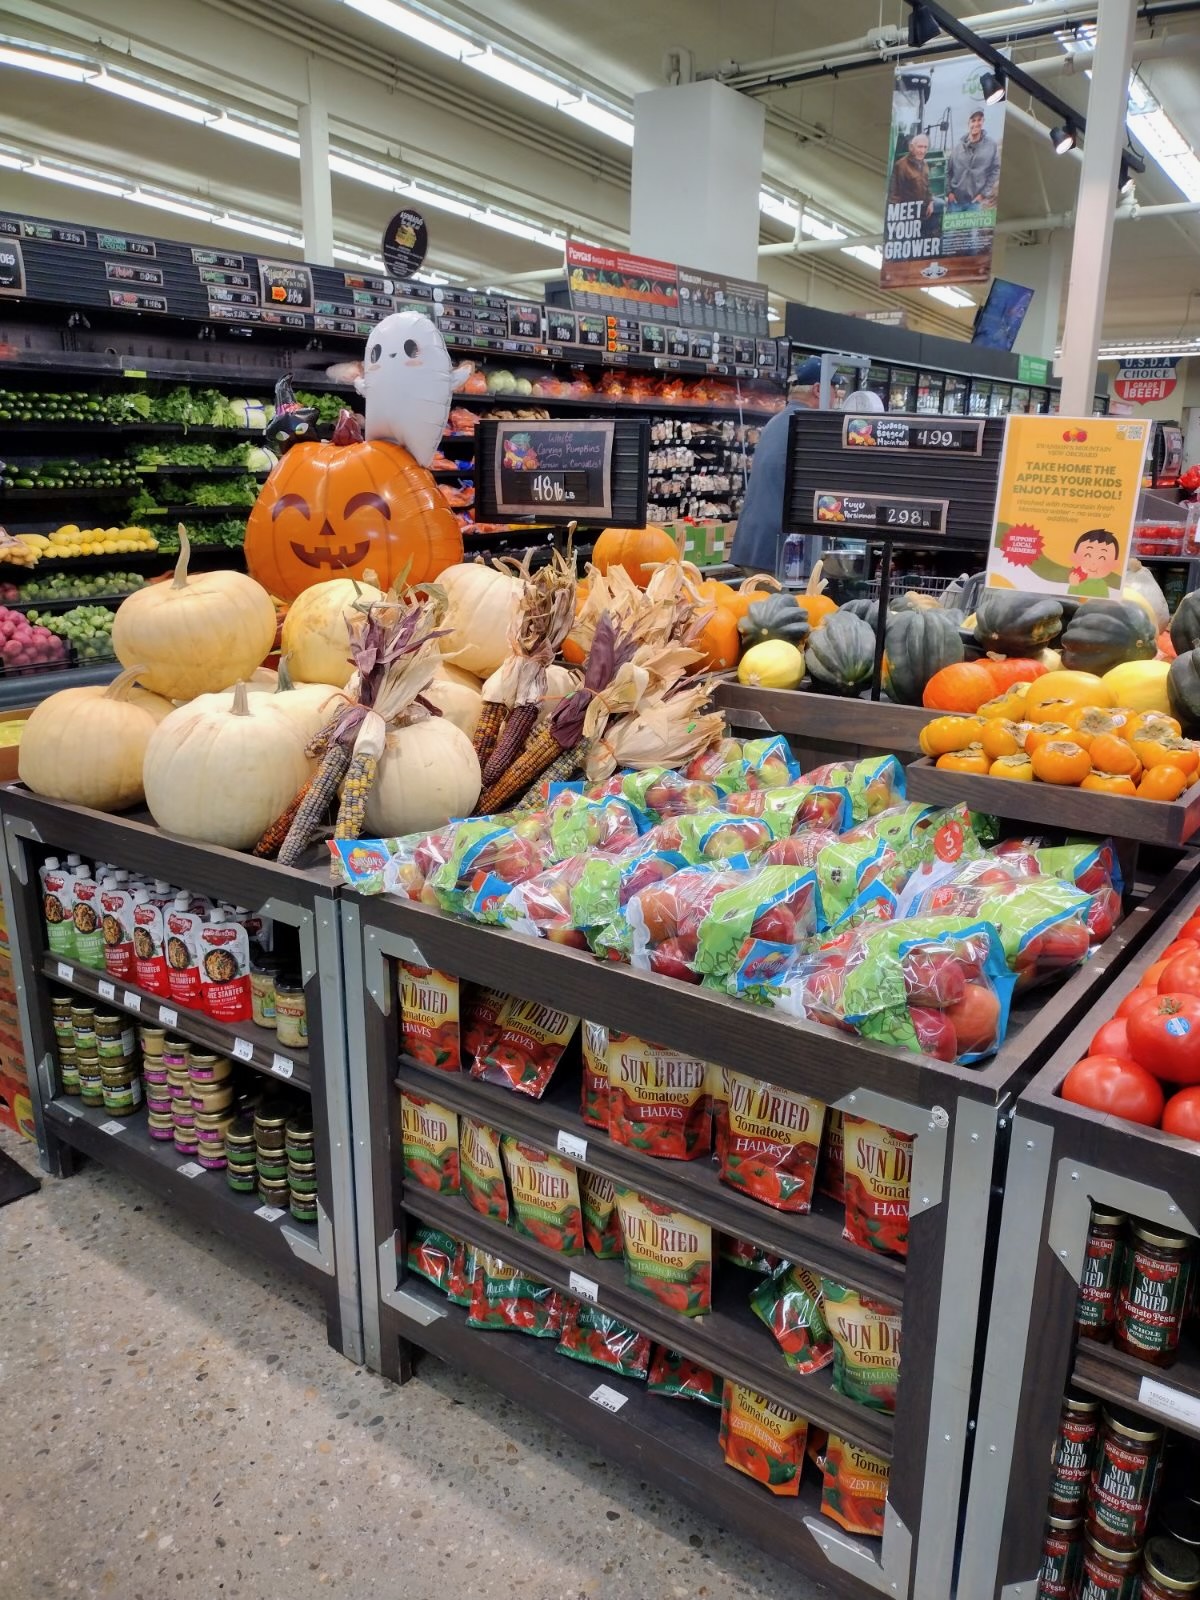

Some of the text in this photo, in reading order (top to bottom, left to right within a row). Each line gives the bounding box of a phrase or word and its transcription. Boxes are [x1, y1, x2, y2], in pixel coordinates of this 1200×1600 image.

[887, 201, 923, 221] MEET
[887, 220, 921, 240] YOUR
[944, 217, 991, 228] CARPINITO
[885, 238, 940, 259] GROWER
[1124, 369, 1169, 378] CHOICE
[1130, 388, 1159, 397] BEEF
[877, 430, 904, 440] Bagged
[566, 444, 600, 456] Pumpkins
[1027, 461, 1116, 475] TAKE HOME THE
[1016, 473, 1122, 488] APPLES YOUR KIDS
[1013, 485, 1122, 500] ENJOY AT SCHOOL!
[844, 498, 865, 512] Fuyu
[1096, 504, 1115, 512] fresh
[1009, 535, 1037, 543] SUPPORT
[944, 831, 954, 849] 3
[411, 982, 447, 1014] DRIED
[525, 1002, 569, 1036] DRIED
[403, 1023, 431, 1037] HALVES
[505, 1017, 547, 1042] Tomatoes
[502, 1032, 535, 1050] HALVES
[621, 1055, 705, 1088] SUN DRIED
[635, 1087, 689, 1104] Tomatoes
[729, 1078, 809, 1132] SUN DRIED
[640, 1107, 683, 1118] HALVES
[413, 1109, 447, 1142] DRIED
[735, 1115, 791, 1144] Tomatoes
[736, 1139, 783, 1158] HALVES
[857, 1137, 888, 1179] SUN
[529, 1166, 569, 1199] DRIED
[870, 1177, 910, 1199] Tomat
[513, 1187, 557, 1211] Tomatoes
[874, 1202, 910, 1216] HALV
[622, 1210, 698, 1253] SUN DRIED
[632, 1241, 683, 1267] Tomatoes
[1151, 1261, 1165, 1269] Sun
[1085, 1271, 1103, 1287] IED
[1142, 1277, 1164, 1297] SUN
[1134, 1288, 1168, 1312] DRIED
[1124, 1300, 1175, 1323] Tomato Pesto
[838, 1316, 871, 1349] SUN
[1129, 1329, 1162, 1343] PINE NUTS
[1132, 1323, 1161, 1337] WHOLE
[854, 1350, 899, 1367] Tomat
[738, 1393, 782, 1435] Tomatoes
[732, 1417, 782, 1454] ZESTY PEPPERS
[1064, 1439, 1084, 1454] SUN
[851, 1452, 890, 1477] Tomat
[1110, 1464, 1132, 1485] SUN
[849, 1478, 876, 1490] ZESTY
[1103, 1474, 1136, 1500] DRIED
[1093, 1483, 1142, 1511] Tomato Pesto
[1100, 1507, 1128, 1523] WHOLE
[1088, 1580, 1107, 1600] SUN
